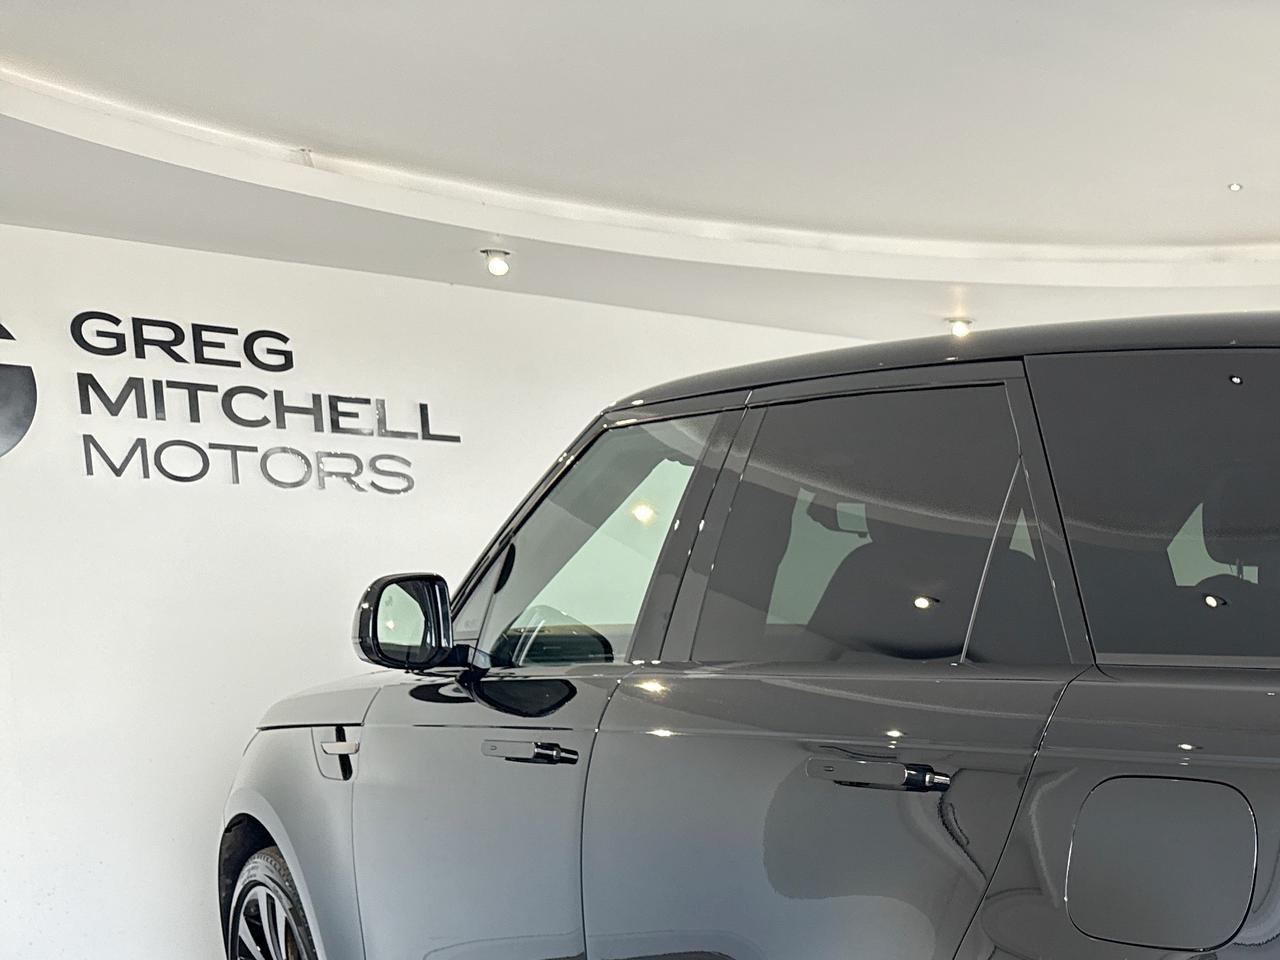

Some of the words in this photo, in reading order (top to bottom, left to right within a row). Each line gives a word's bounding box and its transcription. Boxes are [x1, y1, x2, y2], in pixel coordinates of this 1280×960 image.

[70, 310, 294, 372] GREG
[76, 372, 461, 443] MITCHELL
[82, 433, 415, 495] MOTORS
